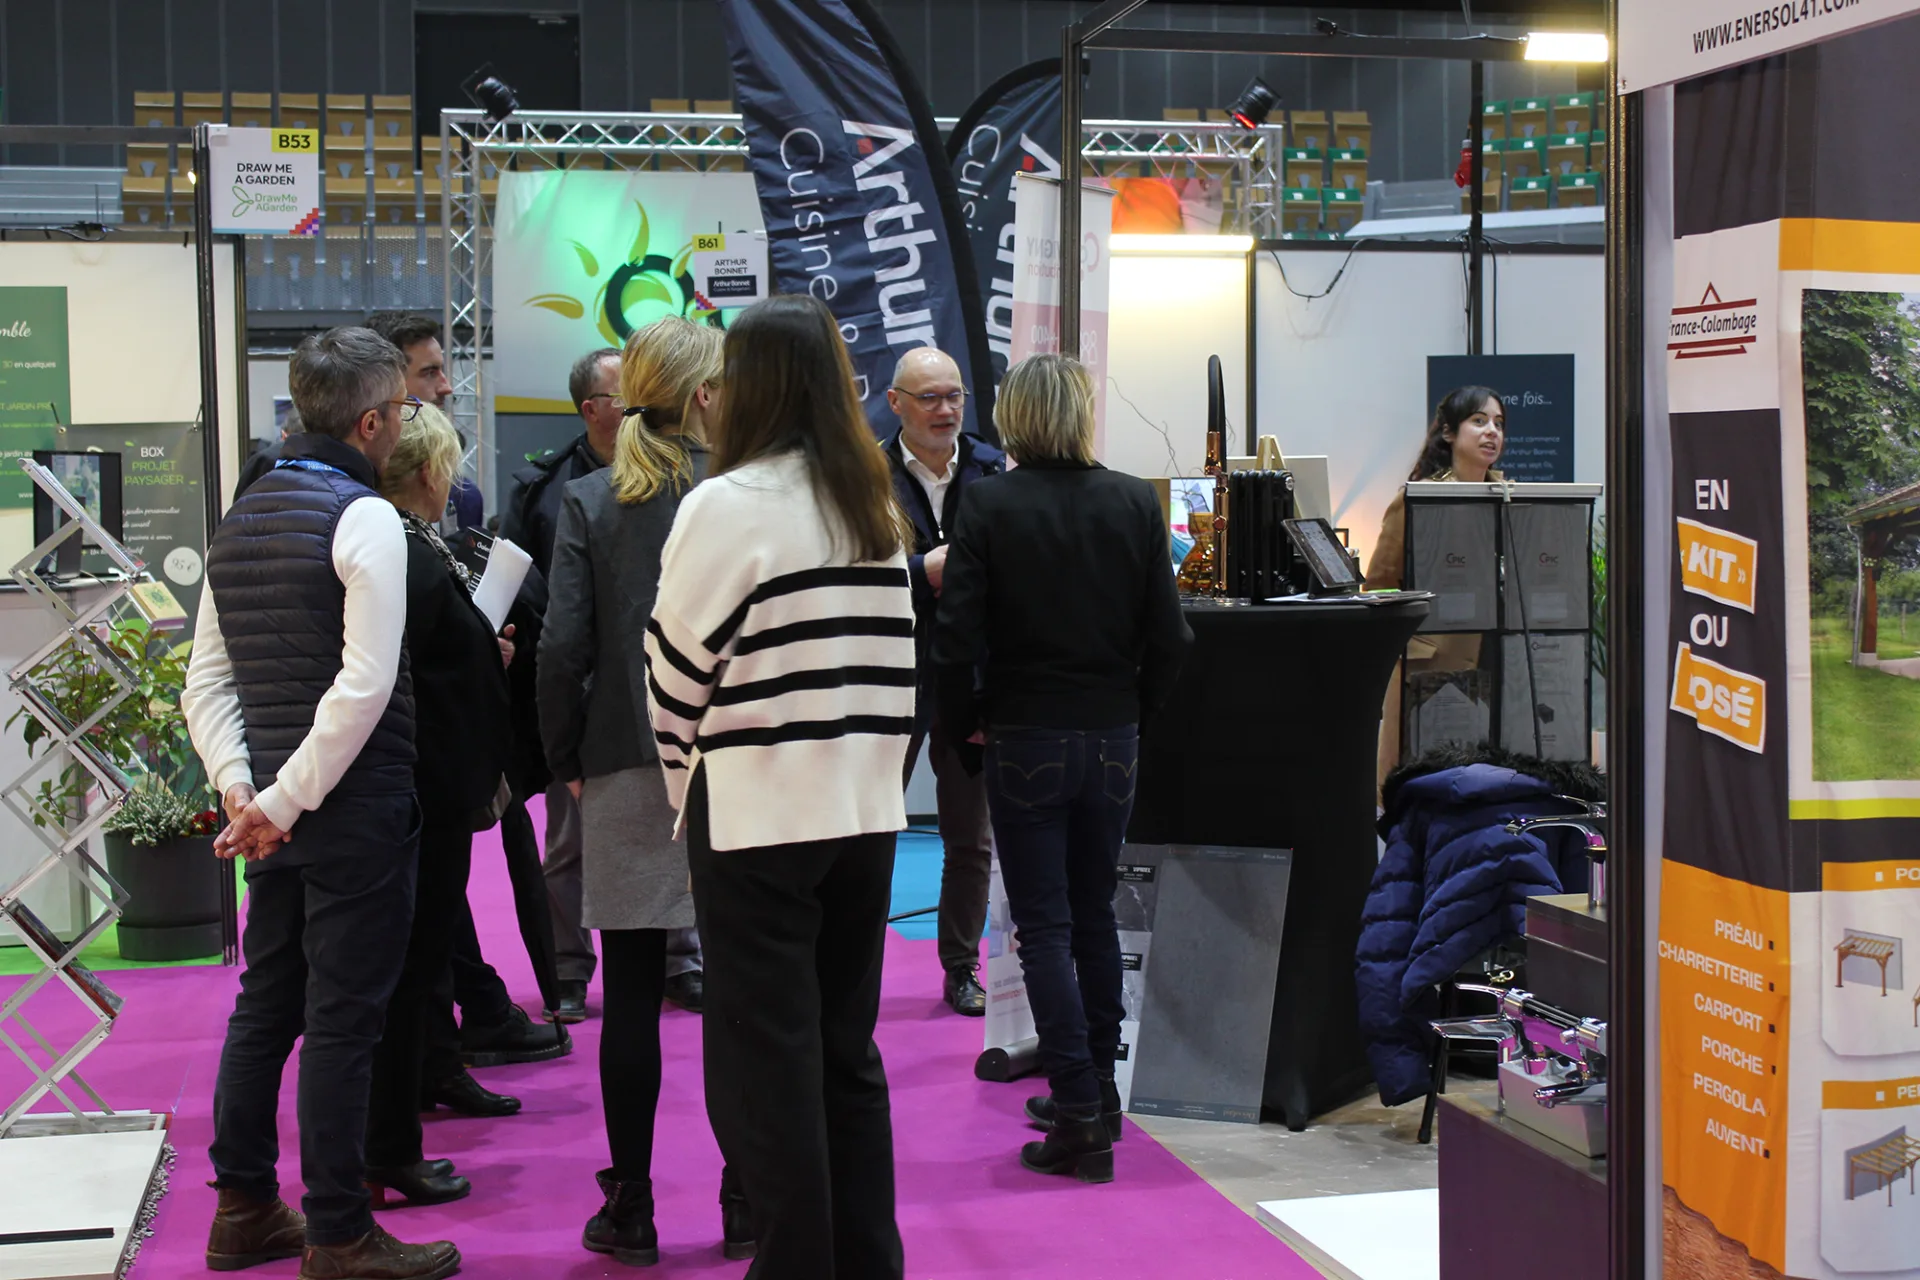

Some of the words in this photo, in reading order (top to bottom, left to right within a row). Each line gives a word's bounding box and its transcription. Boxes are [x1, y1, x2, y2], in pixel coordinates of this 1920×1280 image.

[1693, 0, 1860, 53] WWW.ENERSOL41.C
[278, 134, 311, 149] B53
[236, 162, 273, 173] DRAW
[275, 163, 292, 174] ME
[234, 174, 243, 184] A
[245, 175, 295, 185] GARDEN
[254, 192, 298, 203] DrawMe
[255, 203, 298, 212] AGarden
[780, 127, 838, 301] Cuisine
[698, 238, 719, 249] B61
[842, 120, 939, 350] Arthur
[714, 258, 747, 267] ARTHUR
[714, 267, 748, 275] BONNET
[1669, 312, 1756, 336] rance-Colombage
[140, 446, 165, 458] BOX
[131, 460, 177, 472] PROJET
[124, 474, 184, 486] PAYSAGER
[1695, 479, 1729, 510] EN
[1689, 613, 1729, 647] OU
[1714, 918, 1764, 951] PRÉAU
[1657, 940, 1764, 992] CHARRETTERIE
[1694, 992, 1763, 1033] CARPORT
[1701, 1034, 1764, 1076] PORCHE
[1693, 1072, 1767, 1117] PERGOLA
[1897, 1084, 1920, 1099] PE
[1705, 1118, 1766, 1157] AUVENT
